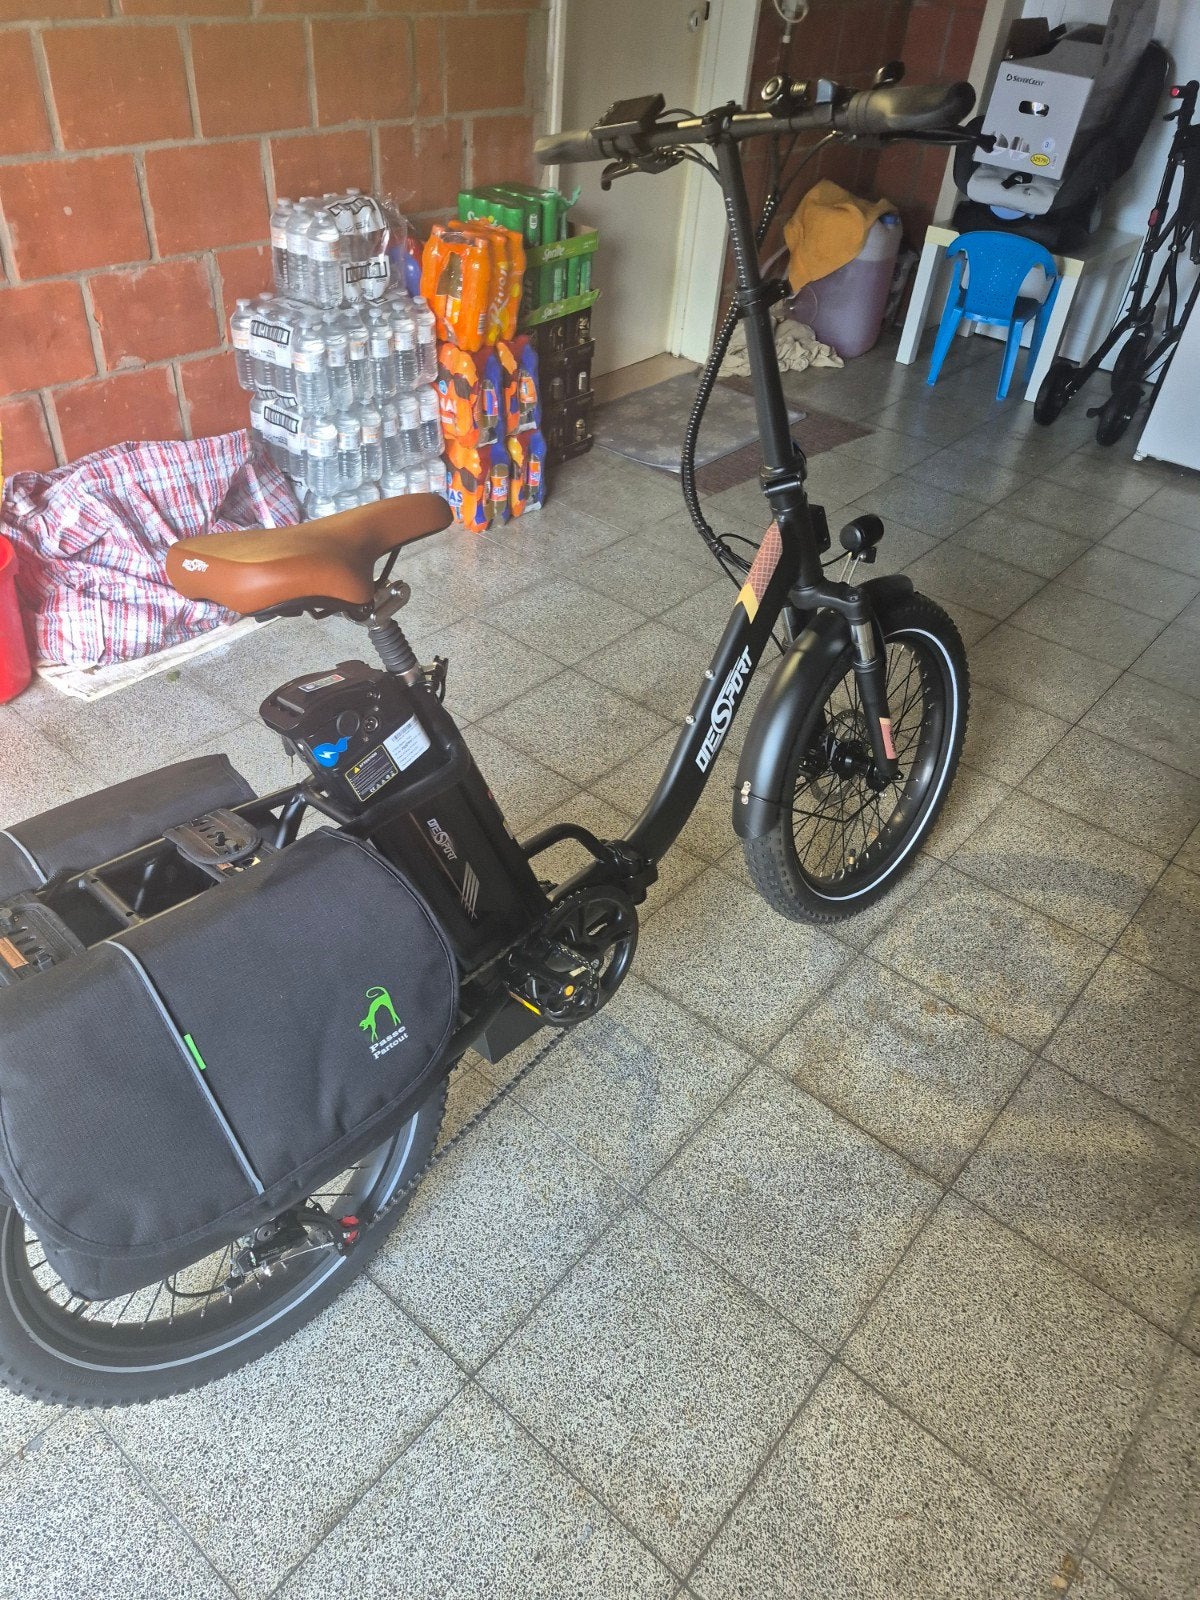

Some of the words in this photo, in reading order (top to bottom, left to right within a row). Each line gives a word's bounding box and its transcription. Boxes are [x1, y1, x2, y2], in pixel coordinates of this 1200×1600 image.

[542, 246, 565, 261] Sprite
[369, 1025, 406, 1053] Passe
[373, 1032, 409, 1060] Partout
